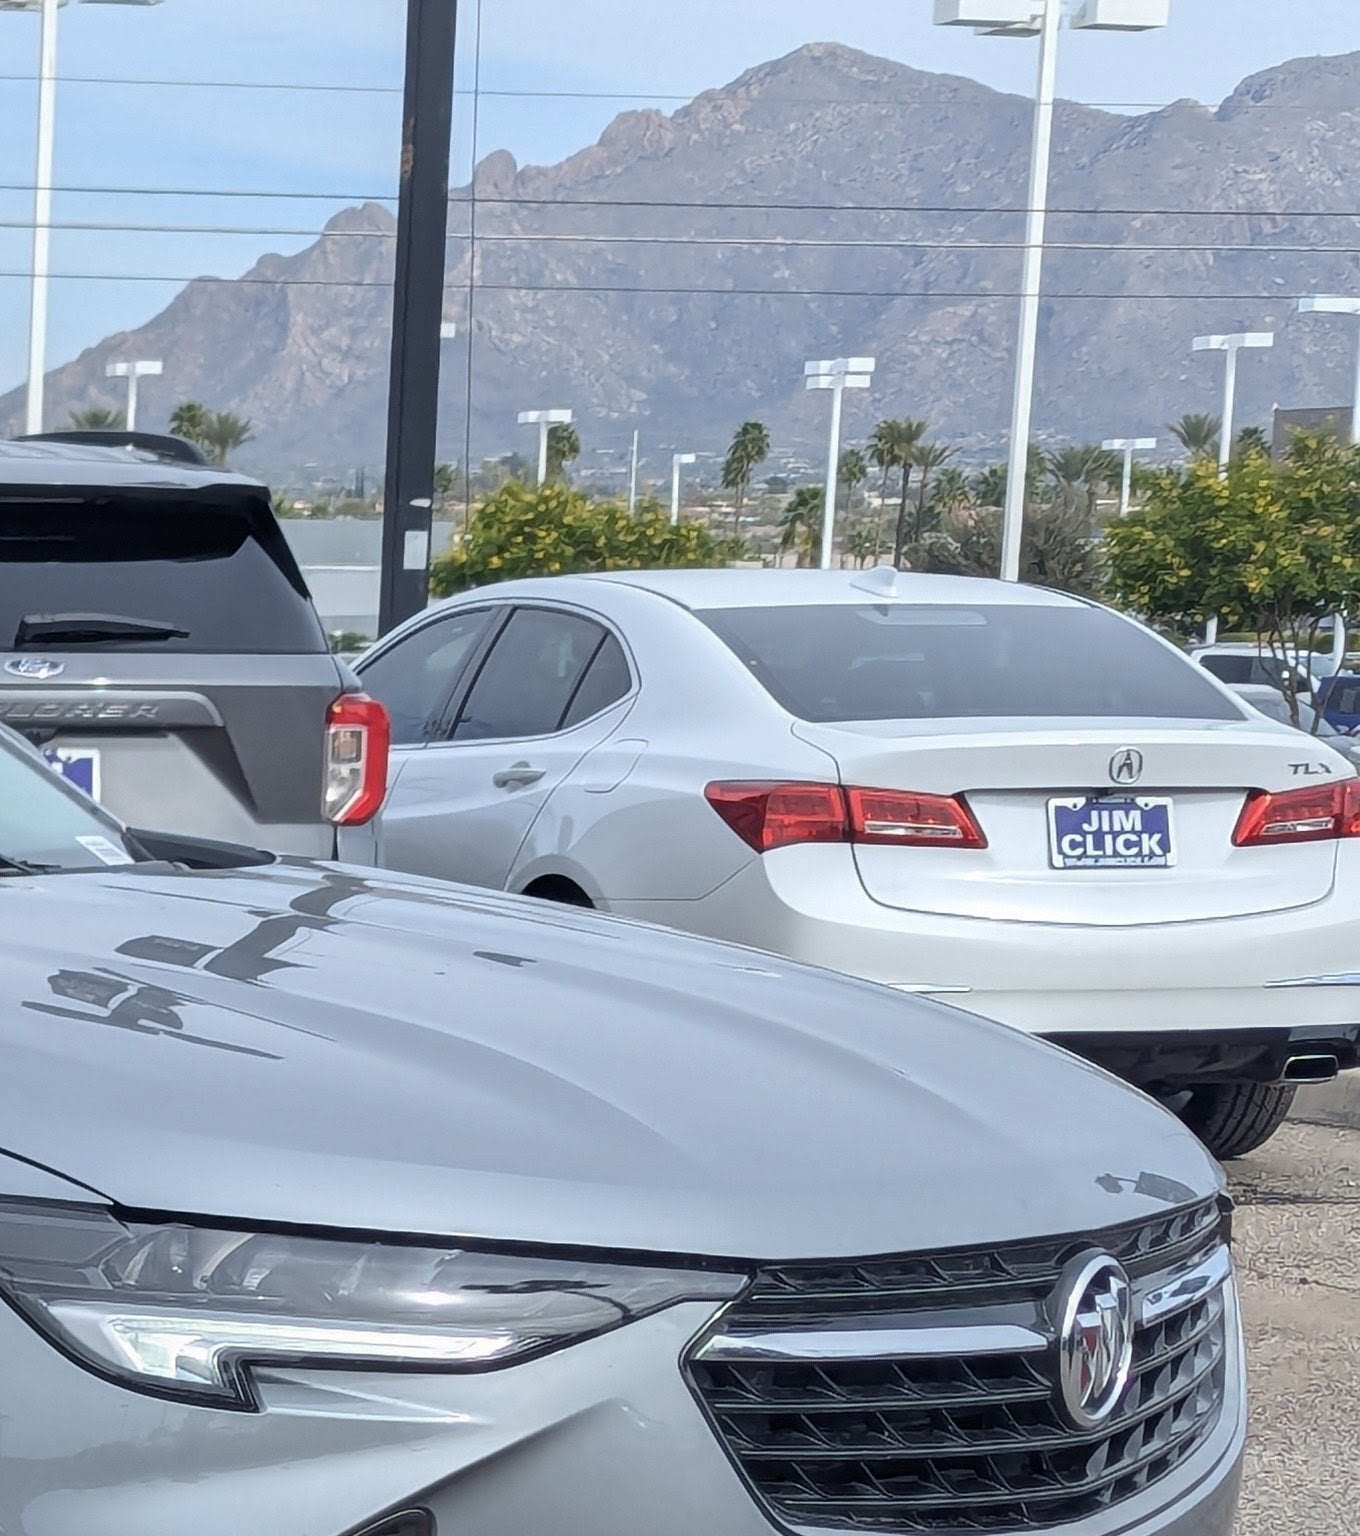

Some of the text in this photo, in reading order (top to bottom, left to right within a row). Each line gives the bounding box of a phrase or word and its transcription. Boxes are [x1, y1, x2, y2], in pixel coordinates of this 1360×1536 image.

[1288, 762, 1333, 775] TLX
[1082, 810, 1142, 831] JIM
[1061, 833, 1164, 856] CLICK
